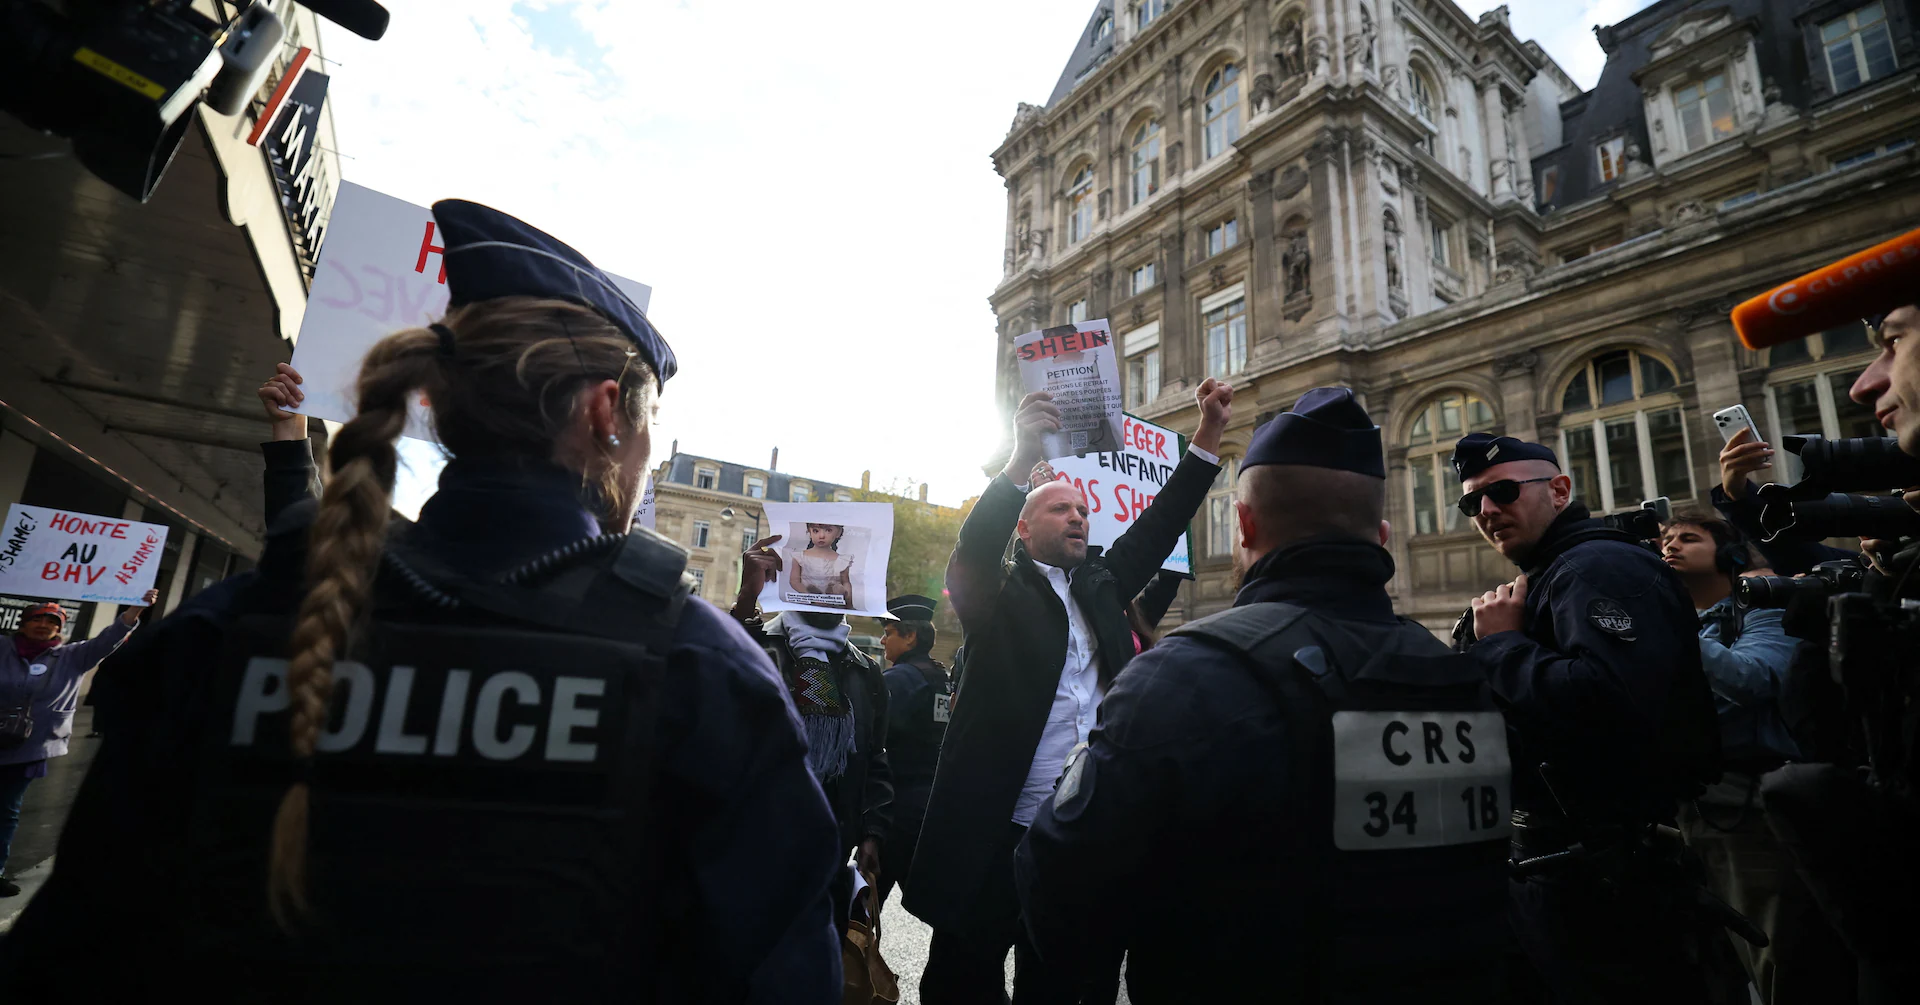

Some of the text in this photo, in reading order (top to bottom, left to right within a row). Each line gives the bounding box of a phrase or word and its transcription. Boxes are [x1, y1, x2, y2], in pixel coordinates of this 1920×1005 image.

[1021, 329, 1108, 360] SHEIN
[1047, 365, 1094, 379] PETITION
[1083, 379, 1109, 387] RETRAIT
[1051, 396, 1111, 406] ORNO-CRIMINELLES
[49, 513, 130, 540] HONTE
[60, 542, 98, 564] AU
[41, 561, 107, 586] BHV
[230, 656, 607, 763] POLICE
[1382, 720, 1476, 767] CRS
[1362, 785, 1500, 838] 34 1B
